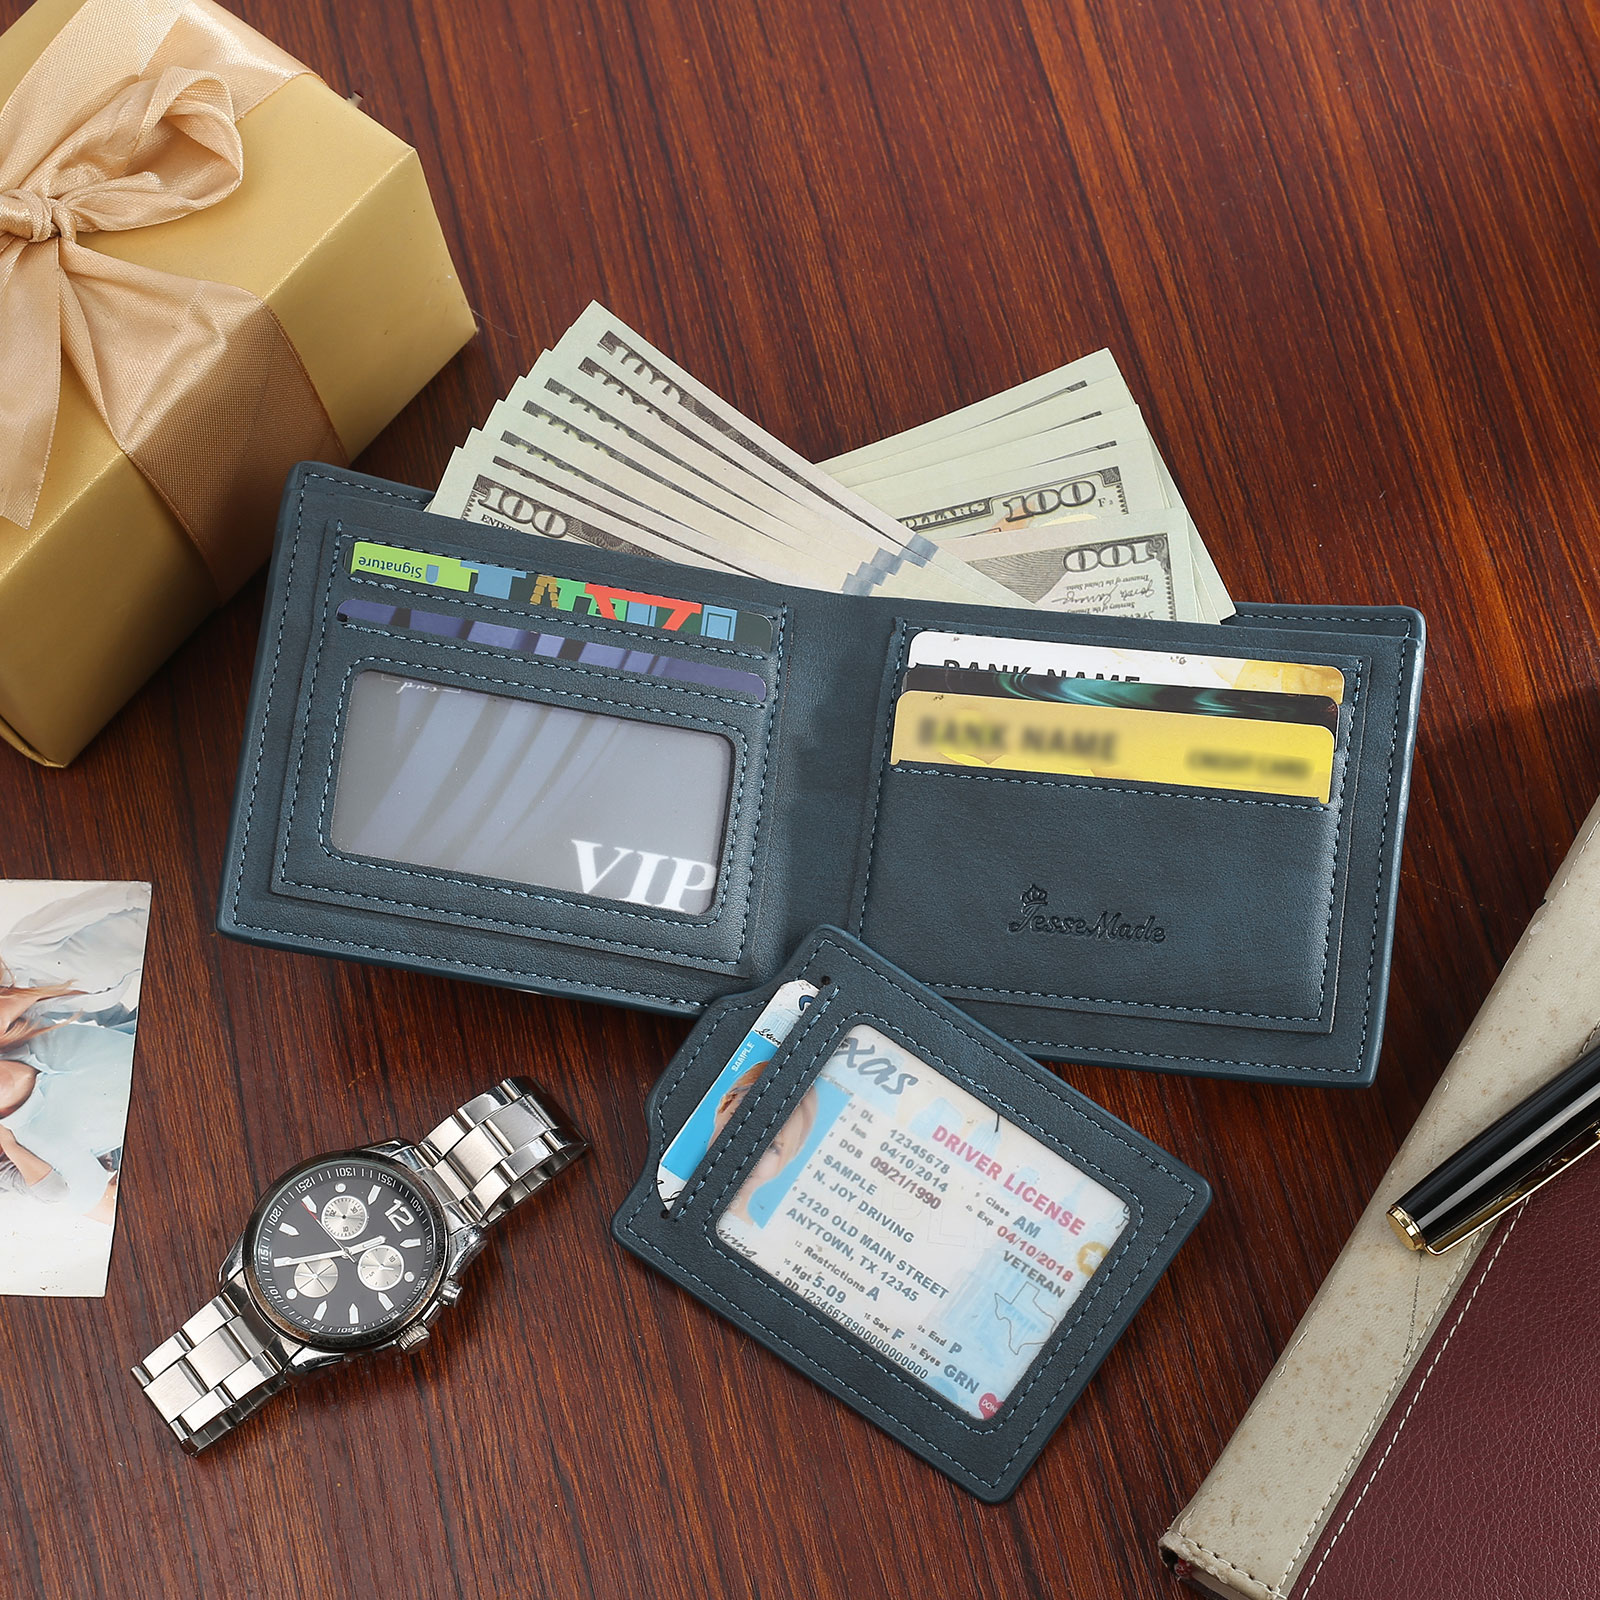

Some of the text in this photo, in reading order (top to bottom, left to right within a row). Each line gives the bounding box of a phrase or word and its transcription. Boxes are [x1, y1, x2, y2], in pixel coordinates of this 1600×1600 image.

[477, 487, 568, 538] 100
[1002, 480, 1096, 523] 100
[358, 556, 422, 578] Signature
[1063, 540, 1157, 572] 100
[571, 838, 717, 911] VIP
[731, 1042, 756, 1072] SAMPLE
[833, 1036, 918, 1095] xas
[860, 1109, 950, 1175] DL 12345678
[880, 1141, 949, 1192] 04/10/2014
[823, 1154, 878, 1196] SAMPLE
[838, 1139, 864, 1159] DOB
[870, 1156, 942, 1210] 09/21/1990
[932, 1125, 1003, 1181] DRIVER
[1003, 1173, 1086, 1236] LICENSE
[384, 1199, 415, 1232] 12
[813, 1170, 826, 1185] N.
[829, 1183, 857, 1204] JOY
[857, 1200, 914, 1243] DRIVING
[986, 1197, 1010, 1217] Class
[1013, 1216, 1042, 1239] AM
[786, 1208, 920, 1302] ANYTOWN, TX 12345
[797, 1191, 829, 1218] 2120
[831, 1215, 859, 1238] OLD
[859, 1233, 896, 1264] MAIN
[896, 1260, 949, 1300] STREET
[977, 1210, 994, 1226] Exp
[997, 1226, 1074, 1283] 04/10/2018
[792, 1264, 812, 1282] Hgt
[812, 1276, 847, 1304] 5-09
[804, 1246, 865, 1293] Restrictions
[866, 1286, 881, 1302] A
[1002, 1250, 1066, 1299] VETERAN
[873, 1317, 890, 1333] Sex
[891, 1328, 905, 1340] F
[928, 1330, 947, 1346] End
[948, 1342, 963, 1353] P
[919, 1348, 941, 1367] Eyes
[944, 1364, 980, 1394] GRN
[982, 1399, 999, 1413] DON
